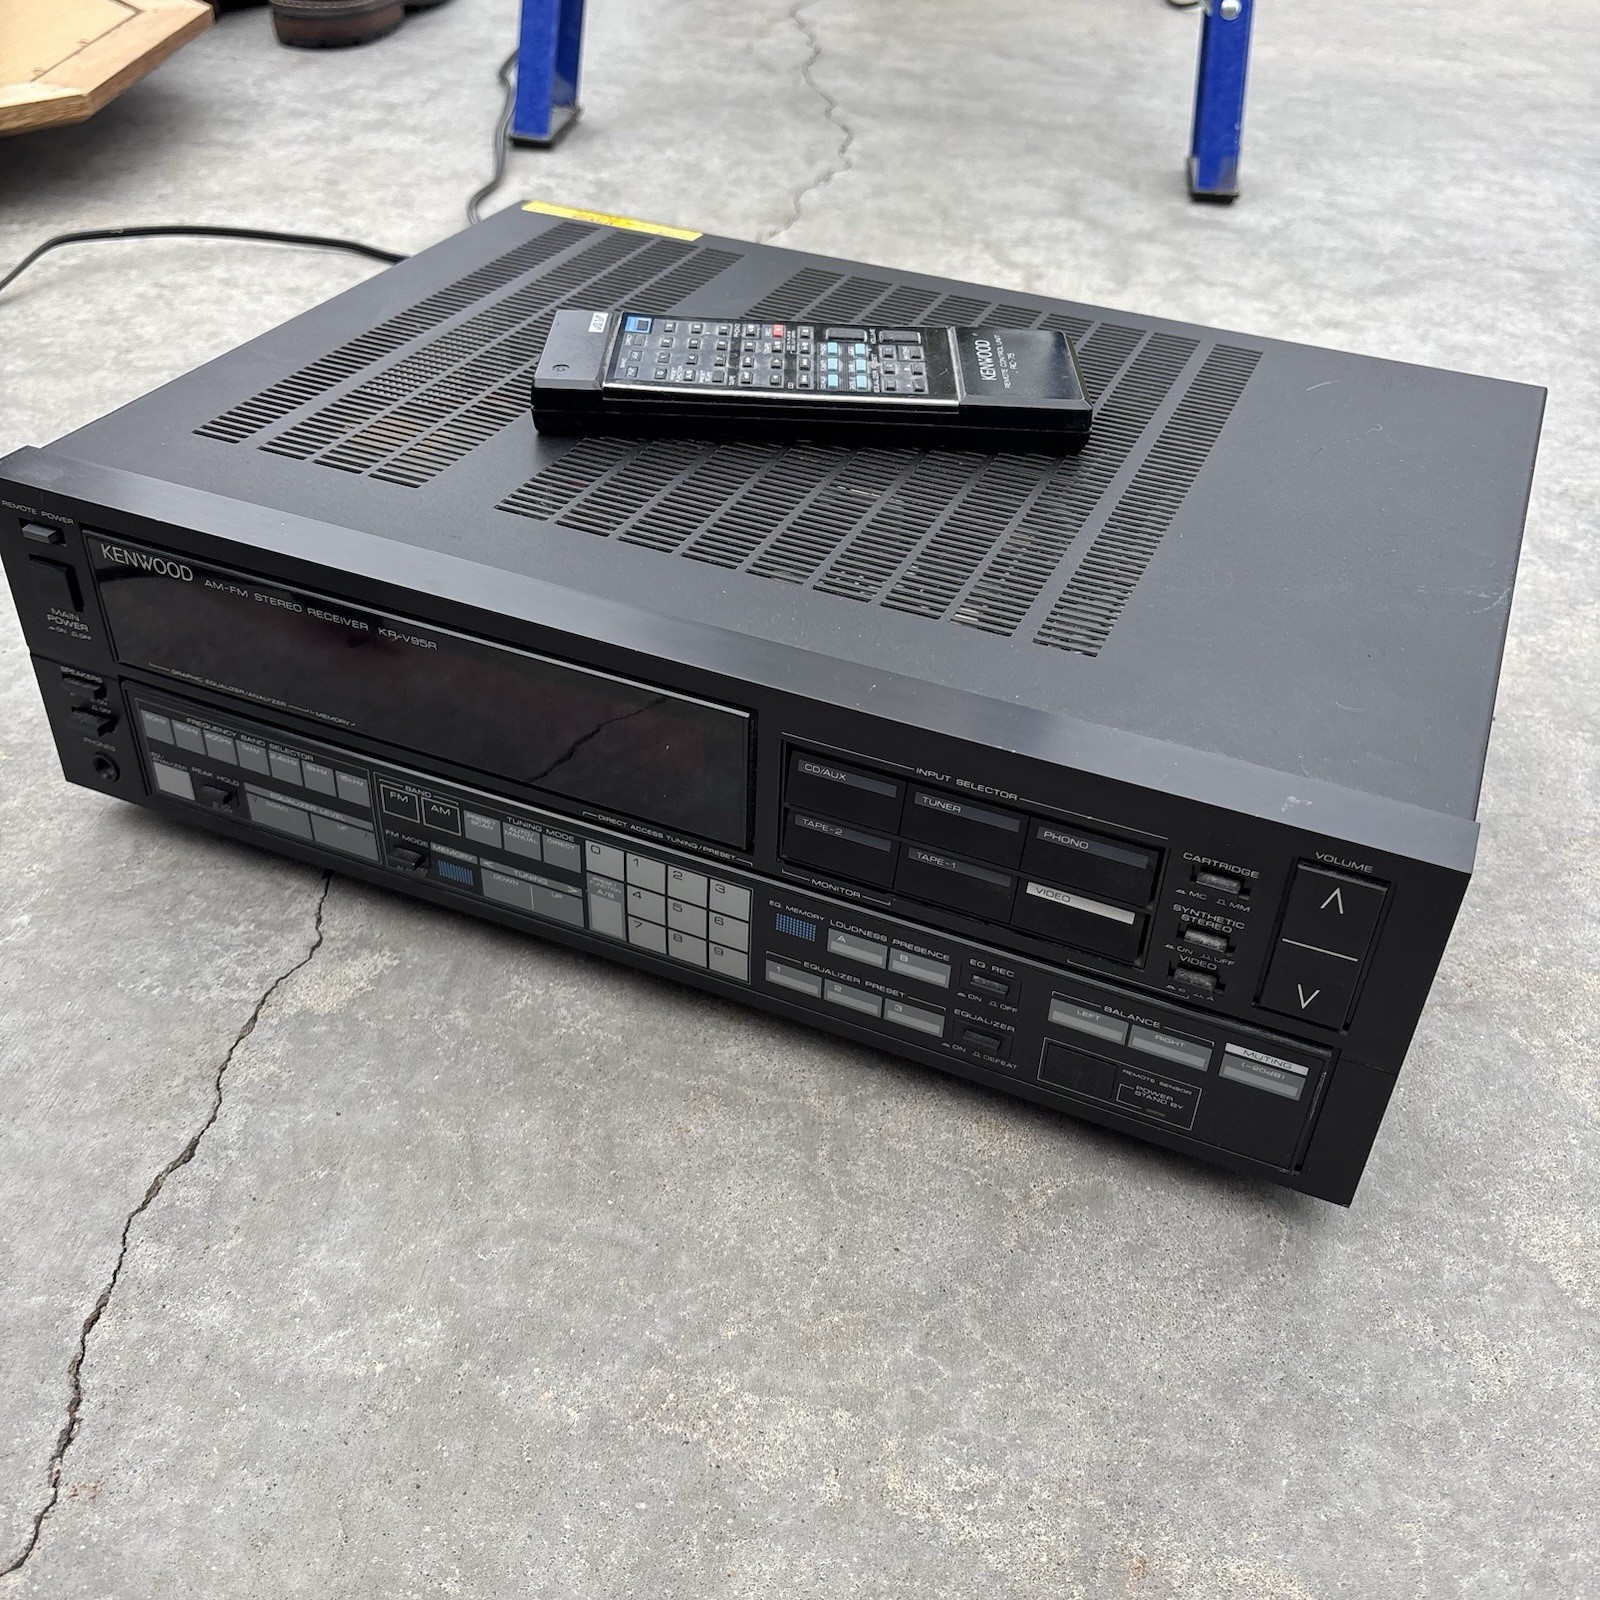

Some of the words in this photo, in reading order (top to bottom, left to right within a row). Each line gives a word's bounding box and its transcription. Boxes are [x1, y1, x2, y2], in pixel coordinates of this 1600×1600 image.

[993, 334, 1003, 346] UNIT
[975, 339, 997, 381] KENWOOD
[996, 346, 1007, 368] CONTROL
[1000, 368, 1011, 389] REMOTE
[1, 500, 37, 515] REMOTE
[41, 511, 75, 525] POWER
[101, 543, 194, 582] KENWOOD
[51, 607, 80, 622] MAIN
[204, 579, 248, 597] AM-FM
[254, 593, 303, 613] STEREO
[307, 607, 369, 632] RECEIVER
[377, 627, 438, 650] KR-V95R
[47, 614, 90, 632] POWER
[60, 665, 103, 683] SPEAKERS
[170, 668, 203, 683] GRAPHIC
[315, 711, 350, 726] MEMORY
[83, 736, 116, 752] PHONES
[186, 717, 236, 737] FREQUENCY
[241, 734, 266, 747] BAND
[269, 743, 314, 762] SELECTOR
[191, 767, 214, 778] PEAK
[216, 775, 239, 787] HOLD
[804, 763, 847, 781] CD/AUX
[404, 784, 432, 798] BAND
[916, 766, 952, 782] INPUT
[955, 778, 1018, 801] SELECTOR
[389, 791, 409, 803] FM
[922, 795, 962, 813] TUNER
[430, 804, 451, 816] AM
[466, 813, 496, 824] PRESET
[470, 820, 494, 831] SCAN
[802, 817, 844, 836] TAPE-2
[504, 830, 538, 844] MANUAL
[507, 816, 542, 833] TUNING
[545, 828, 575, 842] MODE
[385, 829, 399, 838] FM
[402, 834, 429, 848] MODE
[547, 838, 575, 850] DIRECT
[597, 814, 627, 828] DIRECT
[630, 824, 664, 839] ACCESS
[665, 834, 736, 861] TUNING/PRESET
[1043, 830, 1090, 850] PHONO
[431, 844, 474, 861] MEMORY
[916, 851, 957, 870] TAPE-1
[632, 858, 640, 867] 1
[1182, 852, 1260, 879] CARTRIDGE
[1315, 851, 1374, 874] VOLUME
[493, 874, 519, 886] DOWN
[513, 869, 548, 885] TUNING
[672, 870, 683, 881] 2
[632, 891, 642, 899] 4
[715, 883, 726, 894] 3
[811, 878, 862, 899] MONITOR
[1035, 886, 1071, 903] VIDEO
[1188, 889, 1208, 901] MC
[672, 903, 683, 913] 5
[785, 904, 825, 922] MEMORY
[1228, 901, 1251, 913] MM
[634, 920, 643, 929] 7
[714, 916, 724, 926] 6
[1172, 903, 1246, 930] SYNTHETIC
[1180, 914, 1233, 934] STEREO
[673, 933, 683, 943] 8
[830, 919, 888, 942] LOUDNESS
[837, 935, 847, 943] A
[714, 946, 724, 956] 9
[892, 938, 951, 961] PRESENCE
[1176, 945, 1193, 955] ON
[900, 953, 909, 963] B
[1179, 954, 1217, 971] VIDEO
[776, 965, 782, 973] 1
[991, 964, 1015, 978] REC
[803, 961, 861, 985] EQUALIZER
[864, 980, 905, 998] PRESET
[834, 984, 843, 993] 2
[968, 993, 982, 1003] ON
[893, 1003, 903, 1012] 3
[1000, 1003, 1018, 1014] OFF
[1076, 1008, 1101, 1021] LEFT
[953, 1008, 1016, 1033] EQUALIZER
[1103, 1005, 1161, 1029] BALANCE
[1155, 1034, 1186, 1048] RIGHT
[951, 1045, 967, 1054] ON
[982, 1054, 1018, 1070] DEFEAT
[1242, 1049, 1292, 1071] MUTING
[1122, 1069, 1156, 1084] REMOTE
[1158, 1081, 1192, 1096] SENSOR
[1134, 1091, 1168, 1106] STAND
[1169, 1102, 1184, 1111] BY
[1135, 1085, 1174, 1101] POWER
